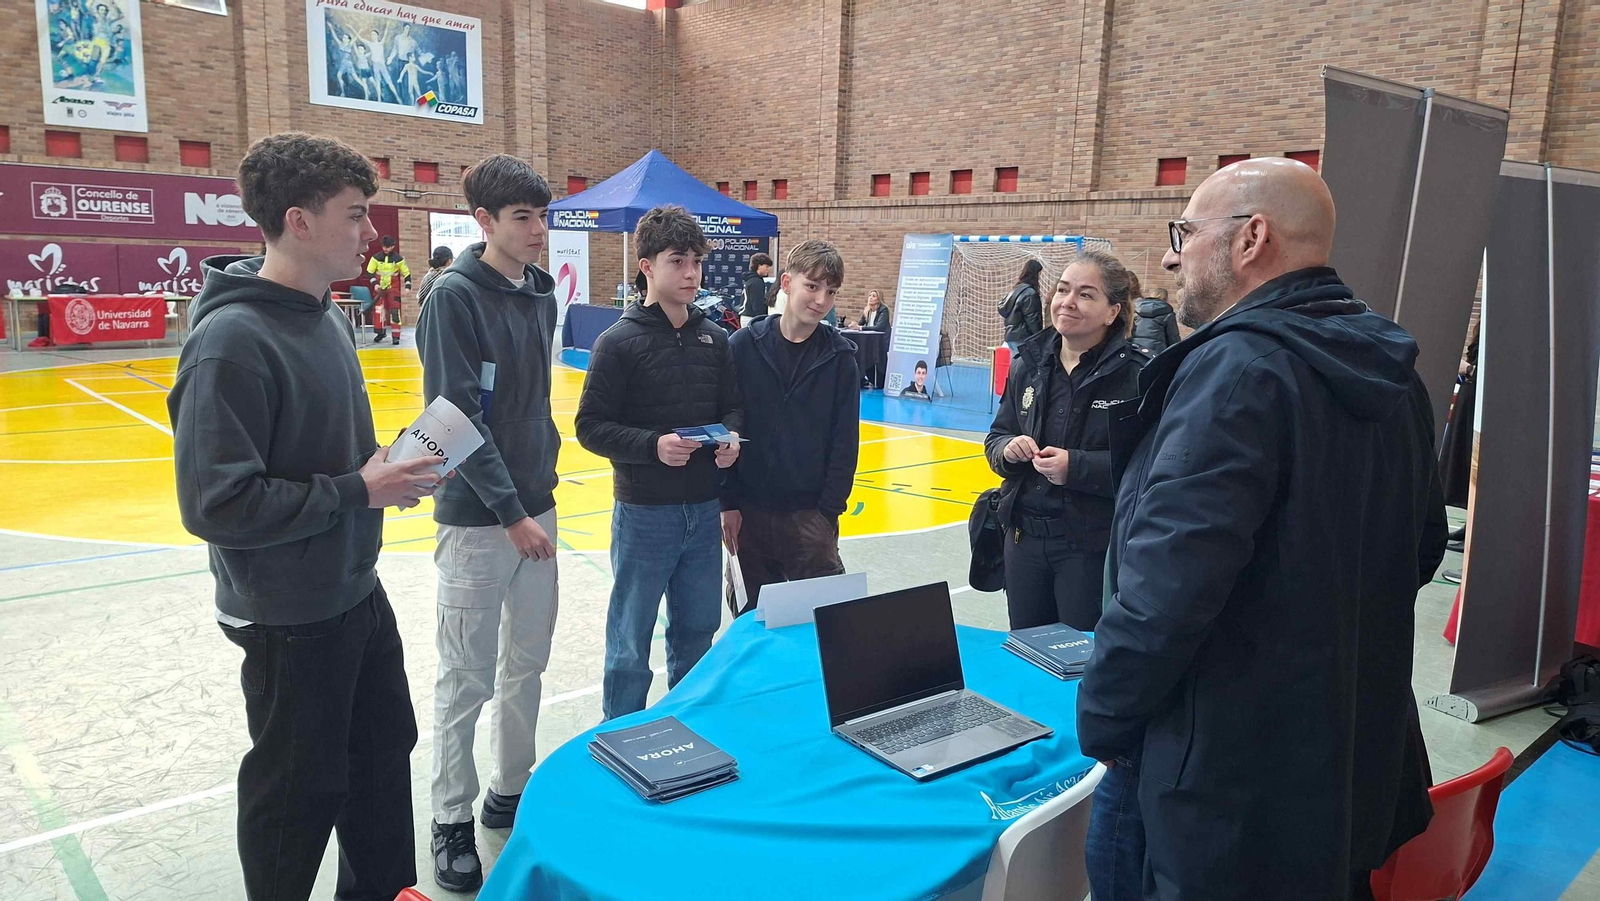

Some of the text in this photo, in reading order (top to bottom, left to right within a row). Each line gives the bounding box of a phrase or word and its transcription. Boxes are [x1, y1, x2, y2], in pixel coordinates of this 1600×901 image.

[353, 0, 393, 15] educar
[396, 7, 417, 22] hay
[421, 15, 442, 26] que
[445, 20, 475, 30] amar
[437, 104, 475, 117] COPASA
[76, 188, 139, 200] Concello de
[77, 199, 150, 214] OURENSE
[558, 211, 591, 219] POLICIA
[558, 219, 599, 228] NACIONAL
[138, 277, 203, 293] marist
[97, 309, 151, 319] Universidad
[98, 320, 149, 330] de Navarra
[636, 742, 695, 761] AHORA
